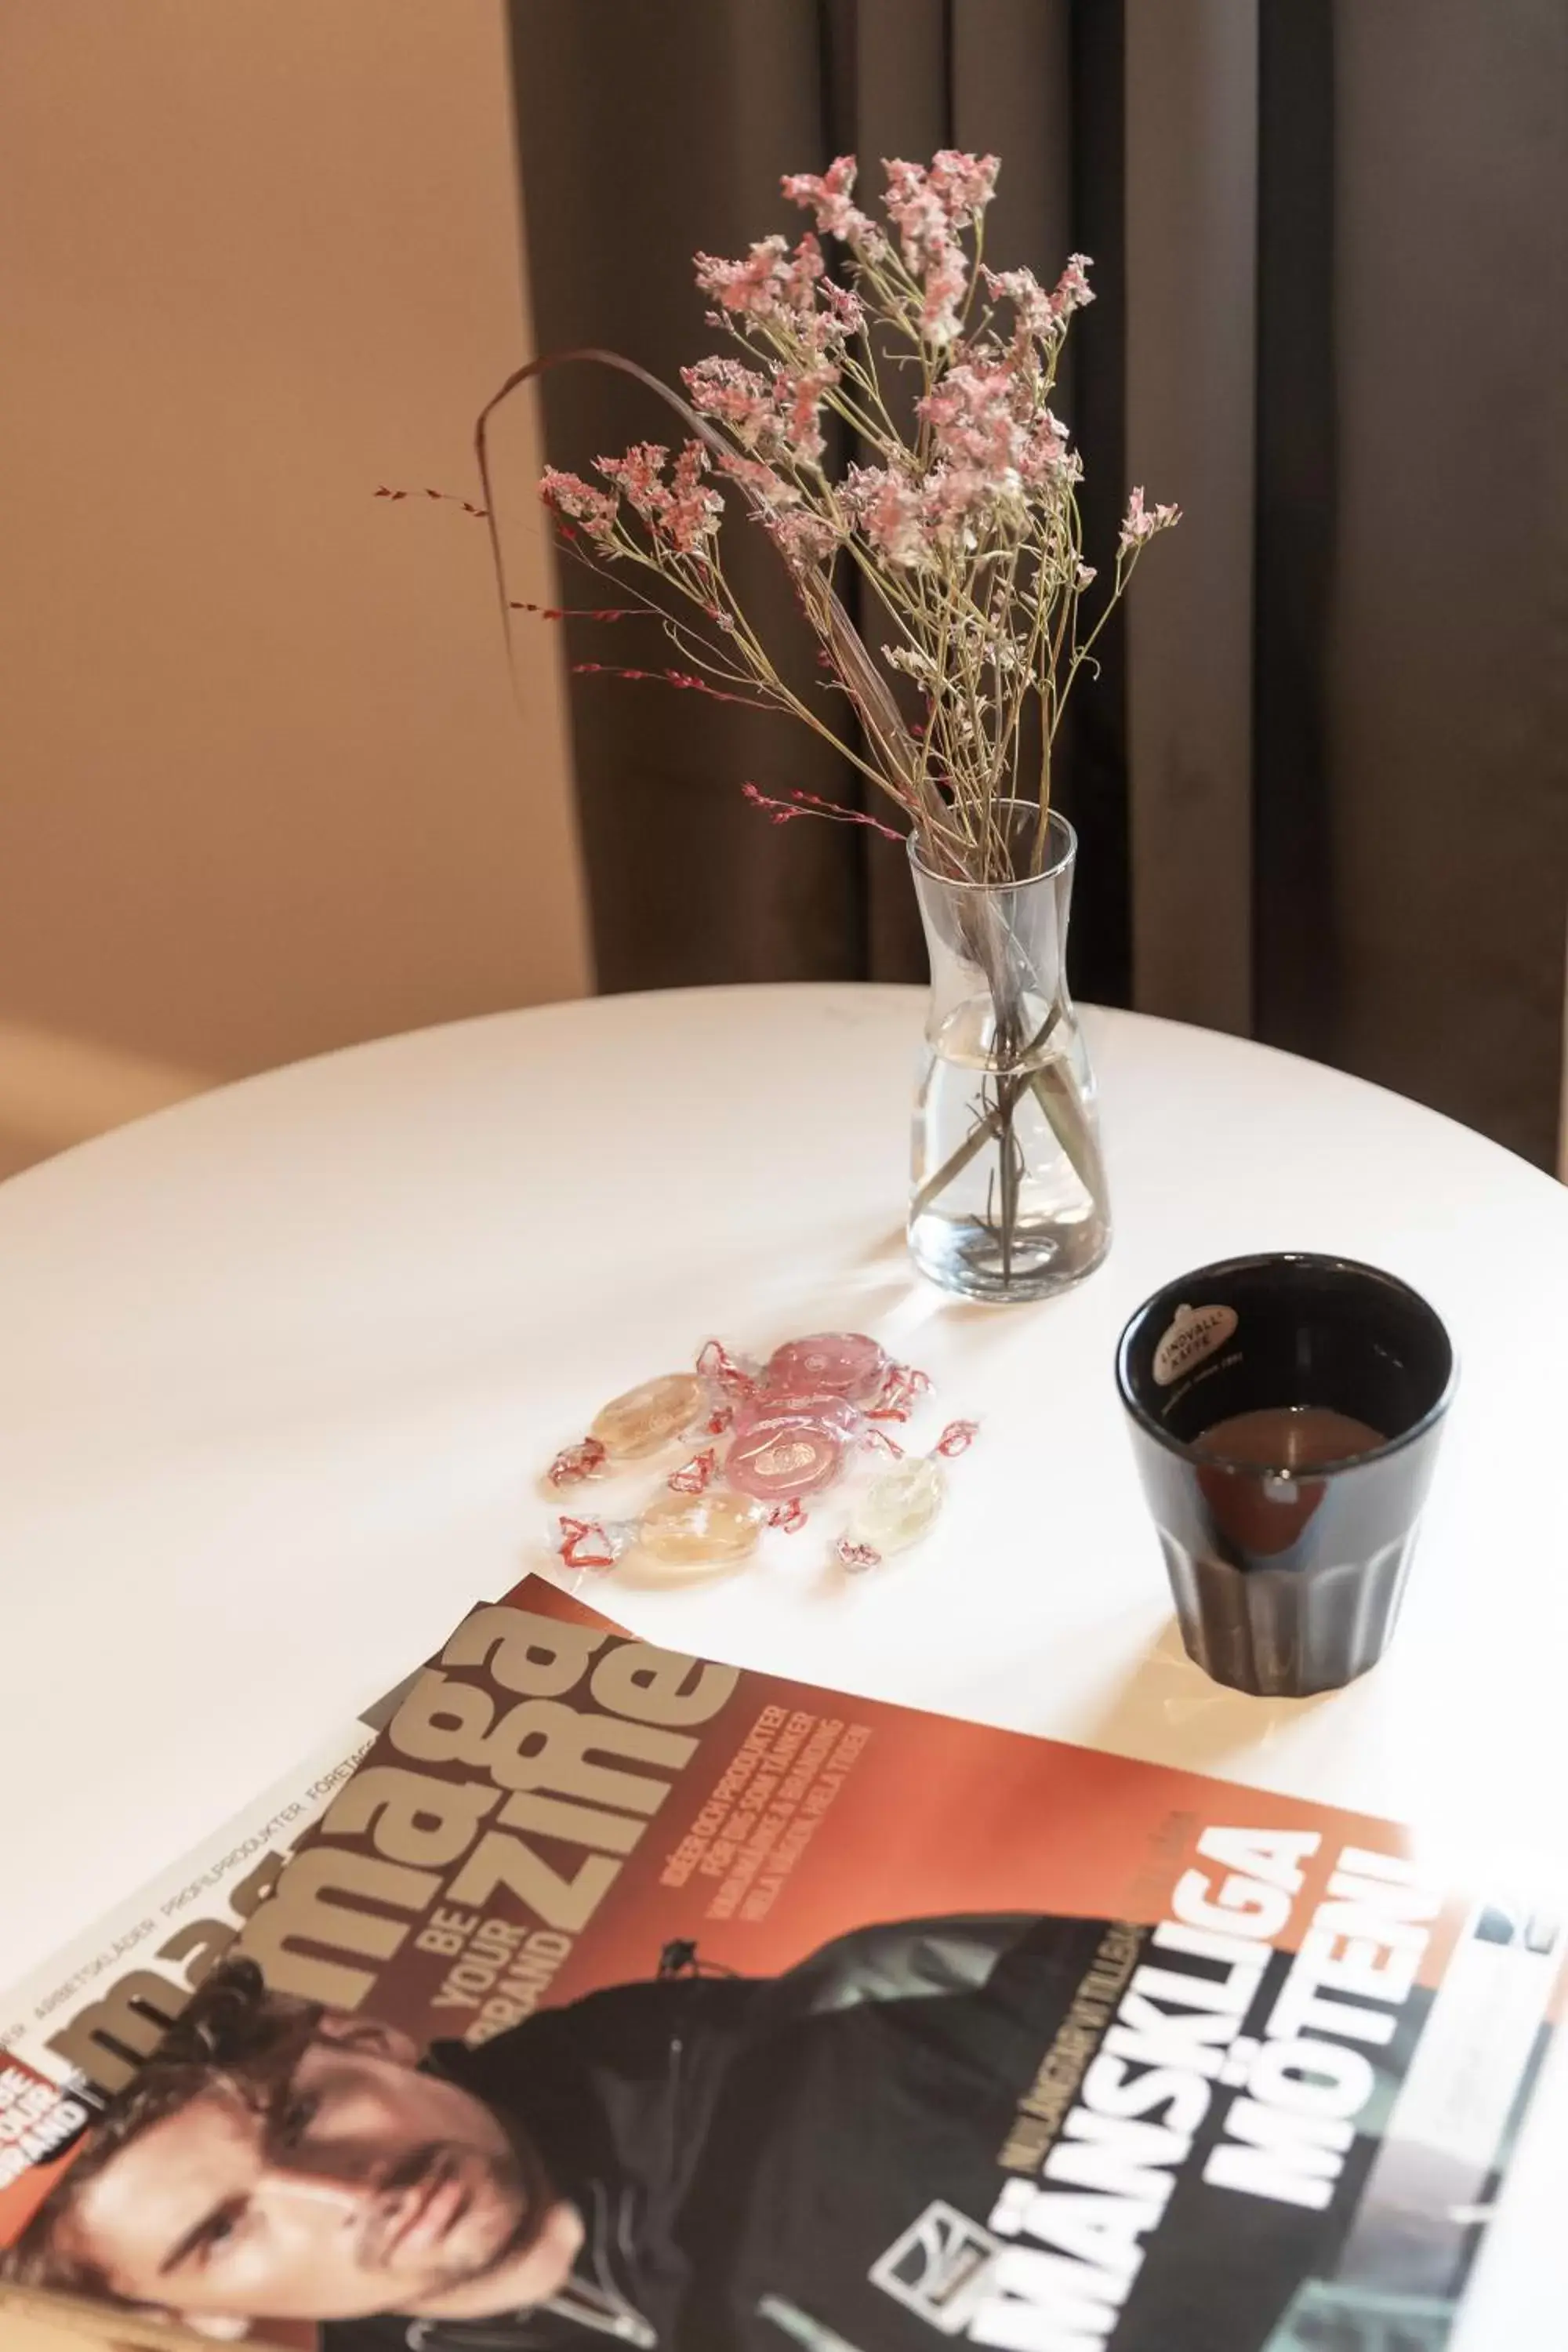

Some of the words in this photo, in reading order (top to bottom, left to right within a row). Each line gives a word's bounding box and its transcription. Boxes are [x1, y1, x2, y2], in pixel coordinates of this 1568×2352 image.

[691, 1799, 731, 1837] OCH
[713, 1704, 790, 1802] PRODUKTER
[414, 1907, 480, 1957] BE
[430, 1919, 528, 2009] YOUR
[967, 1826, 1323, 2352] MÄNSKLIGA
